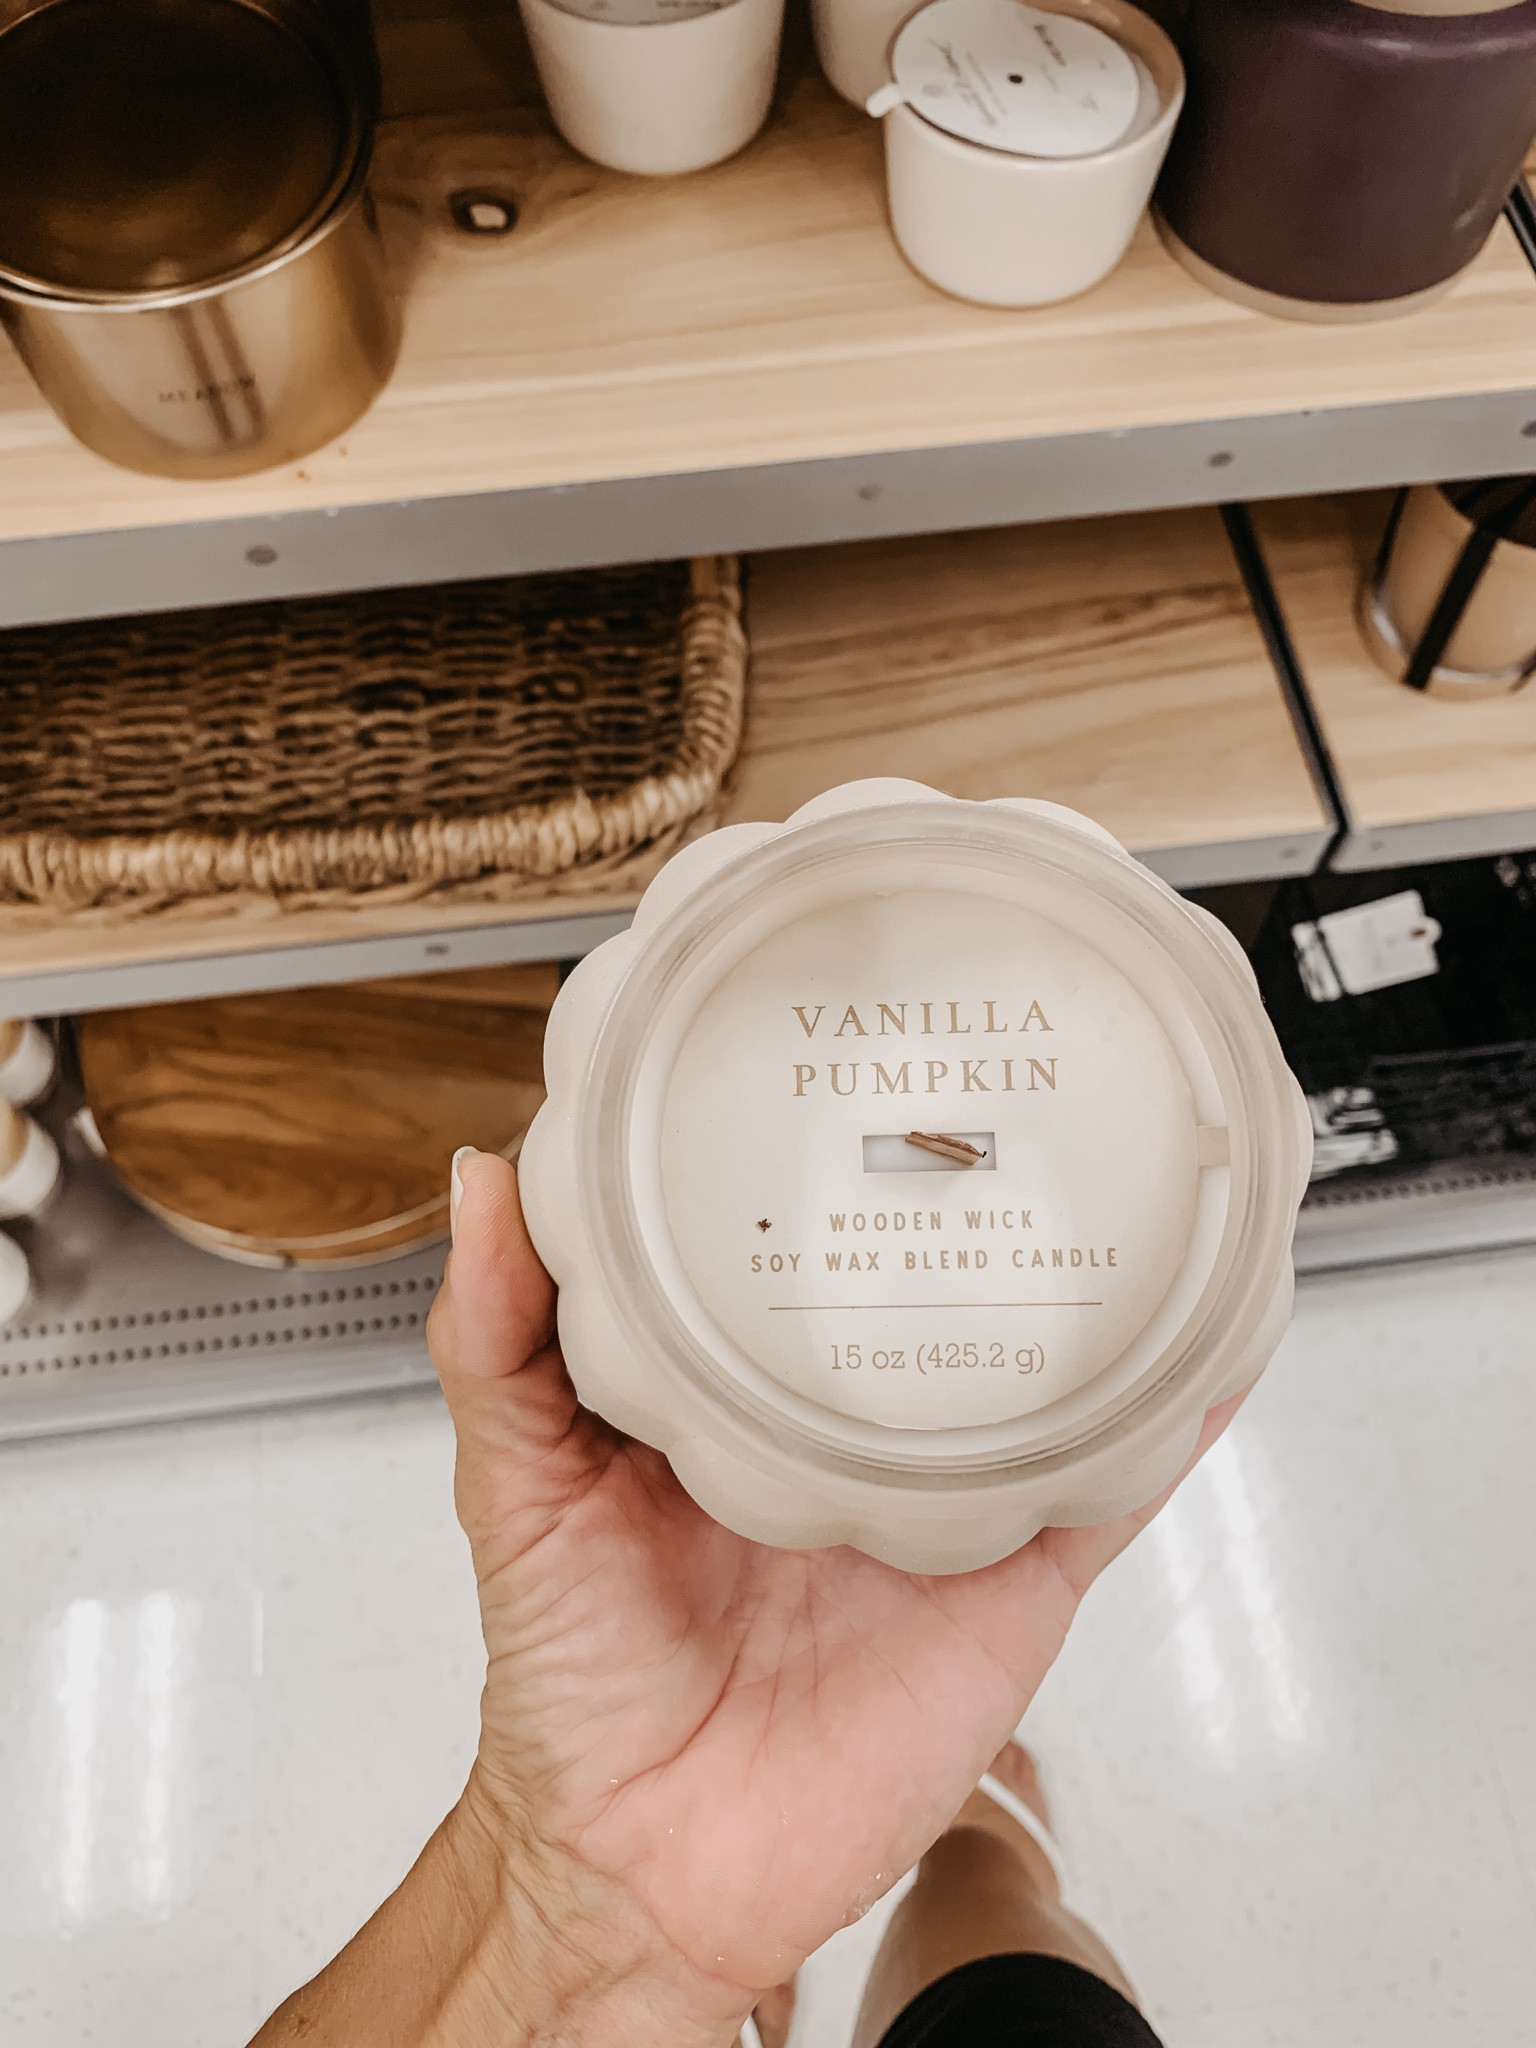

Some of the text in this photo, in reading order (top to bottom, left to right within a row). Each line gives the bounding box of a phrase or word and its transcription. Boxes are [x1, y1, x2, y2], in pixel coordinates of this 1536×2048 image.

[790, 999, 1055, 1039] VANILLA
[792, 1057, 1059, 1097] PUMPKIN
[828, 1209, 1033, 1233] WOODEN WICK
[751, 1247, 1118, 1274] SOY WAX BLEND CANDLE
[831, 1341, 1045, 1376] 15 oz (425.2 g)
